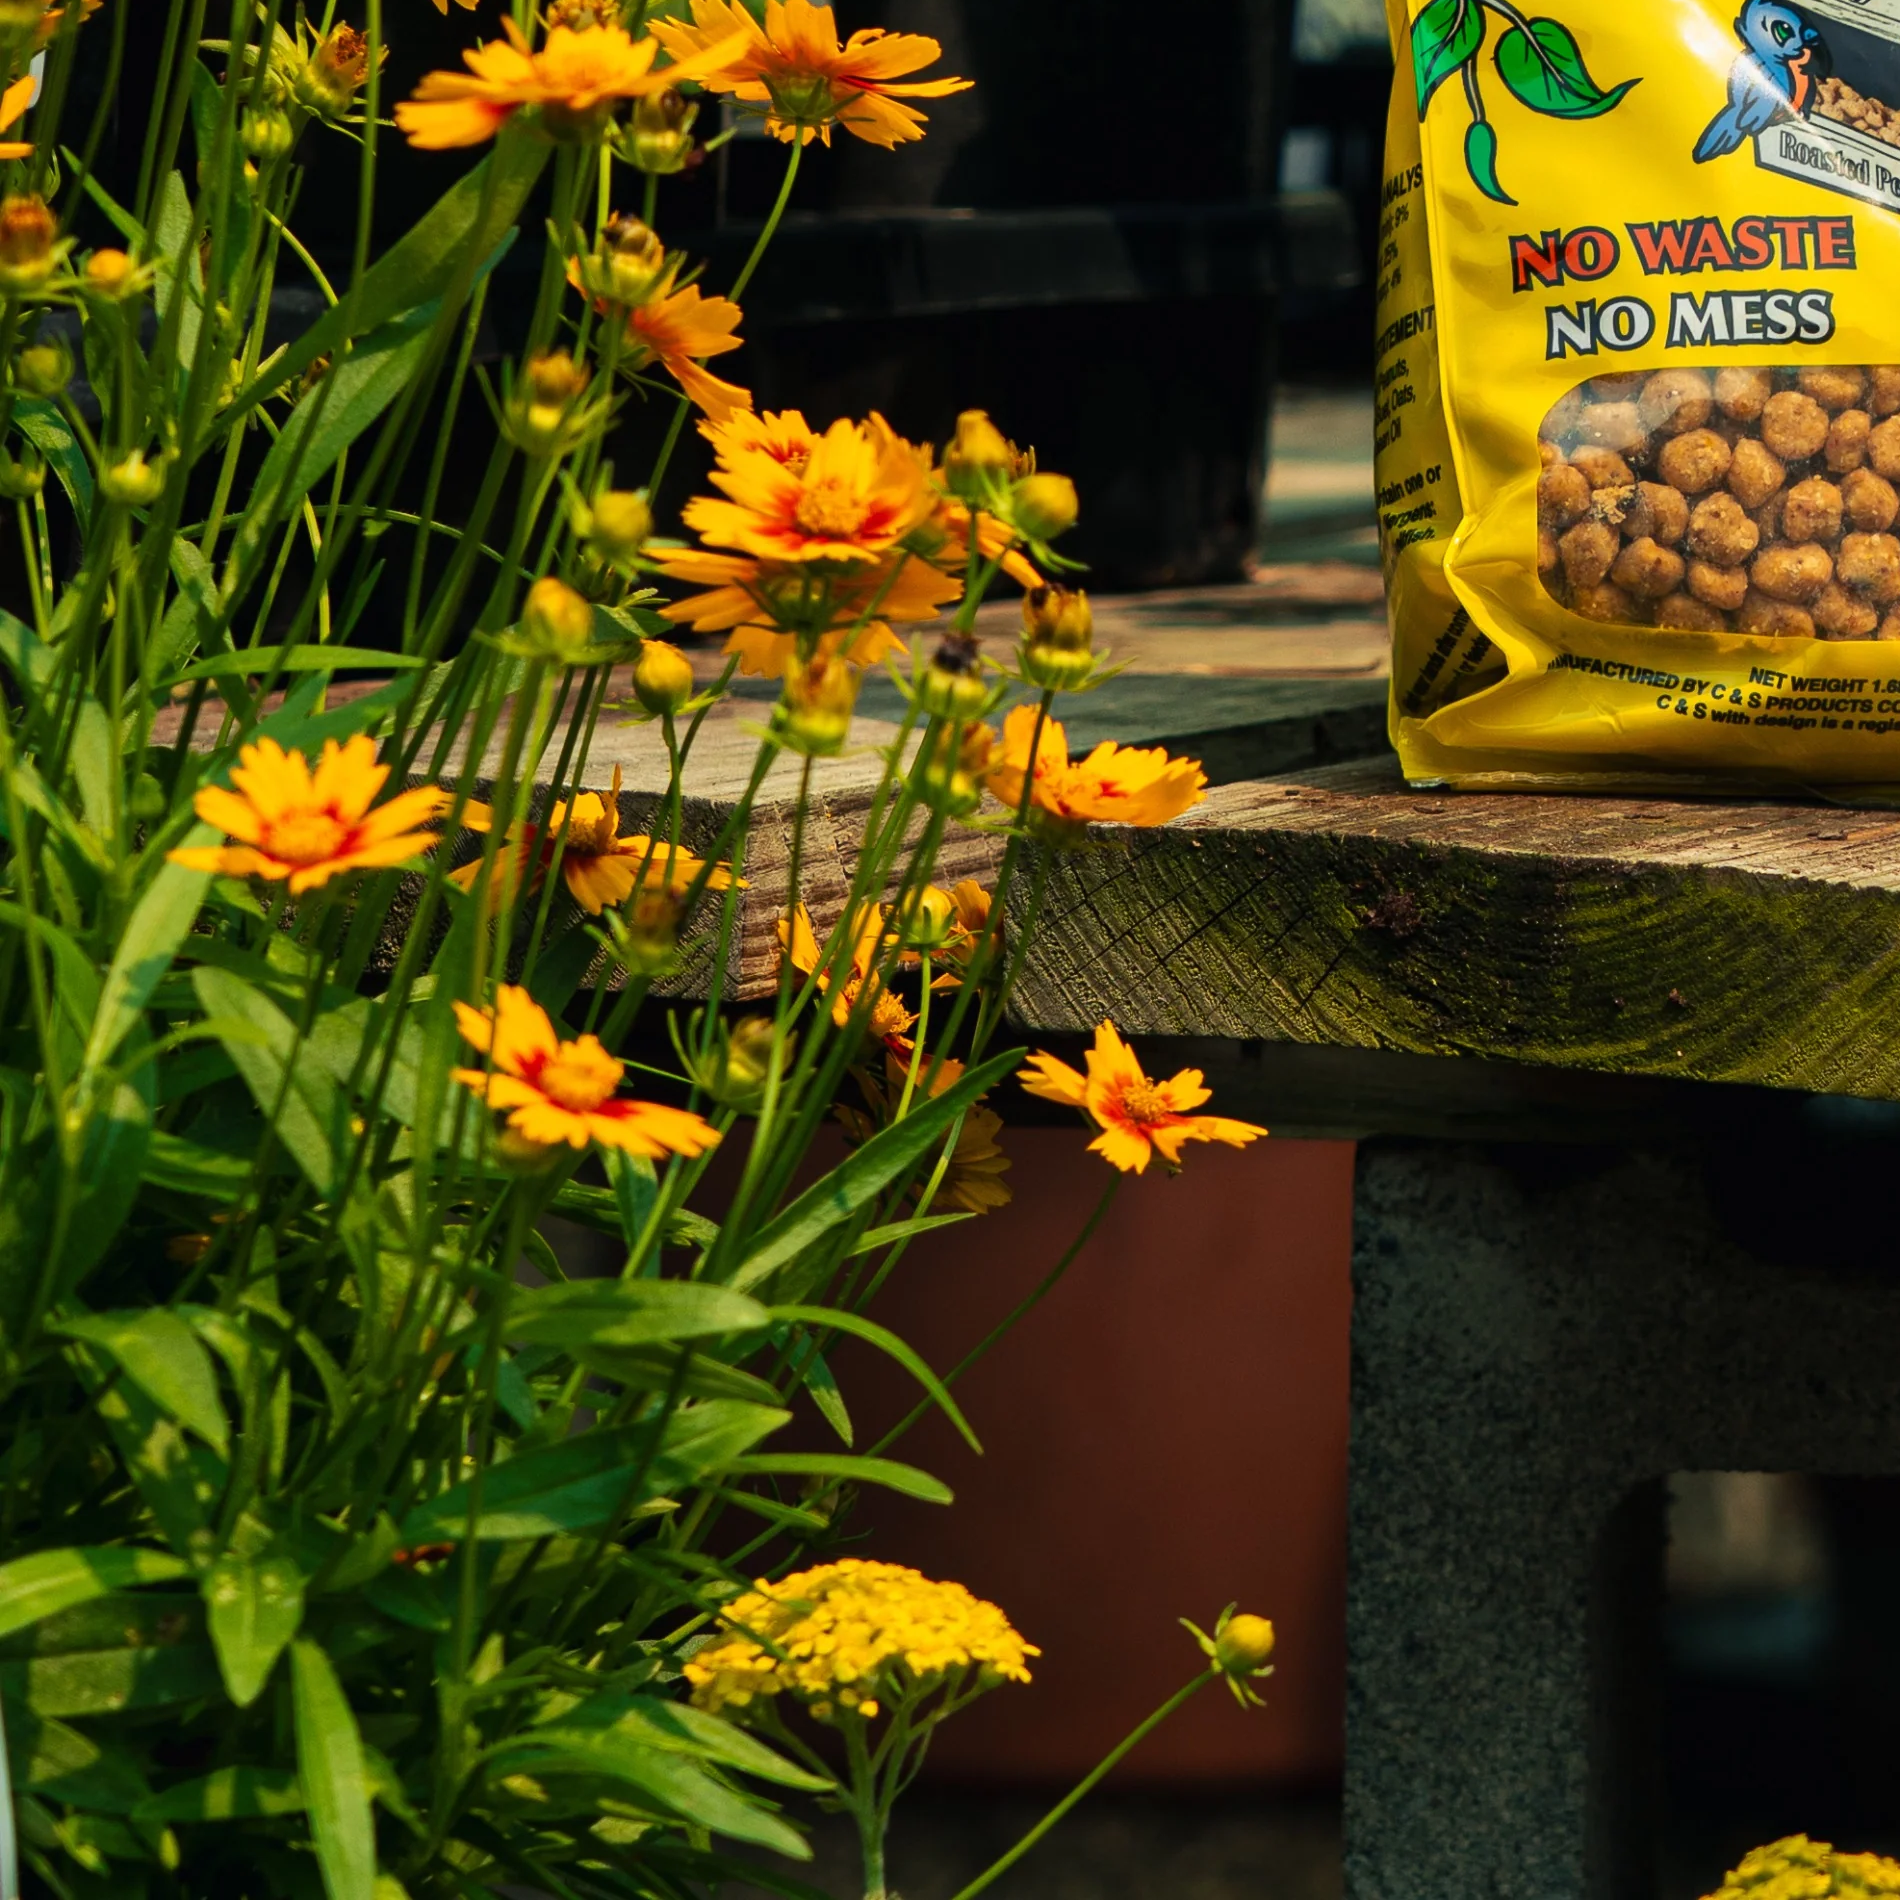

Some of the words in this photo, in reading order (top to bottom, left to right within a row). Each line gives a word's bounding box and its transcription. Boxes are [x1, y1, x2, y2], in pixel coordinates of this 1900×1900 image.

[1779, 129, 1870, 187] Roasted
[1508, 225, 1621, 294] NO
[1625, 215, 1857, 276] WASTE
[1545, 295, 1656, 361] NO
[1664, 289, 1836, 349] MESS
[1426, 464, 1442, 485] or
[1681, 677, 1711, 695] BY
[1711, 683, 1727, 700] C
[1729, 688, 1743, 705] &
[1747, 691, 1762, 709] S
[1766, 695, 1874, 713] PRODUCTS
[1748, 666, 1789, 690] NET
[1791, 675, 1868, 693] WEIGHT
[1656, 694, 1672, 710] C
[1674, 698, 1689, 715] &
[1692, 702, 1708, 720] S
[1711, 708, 1750, 726] with
[1754, 714, 1817, 731] design
[1821, 715, 1838, 729] is
[1841, 719, 1854, 730] a
